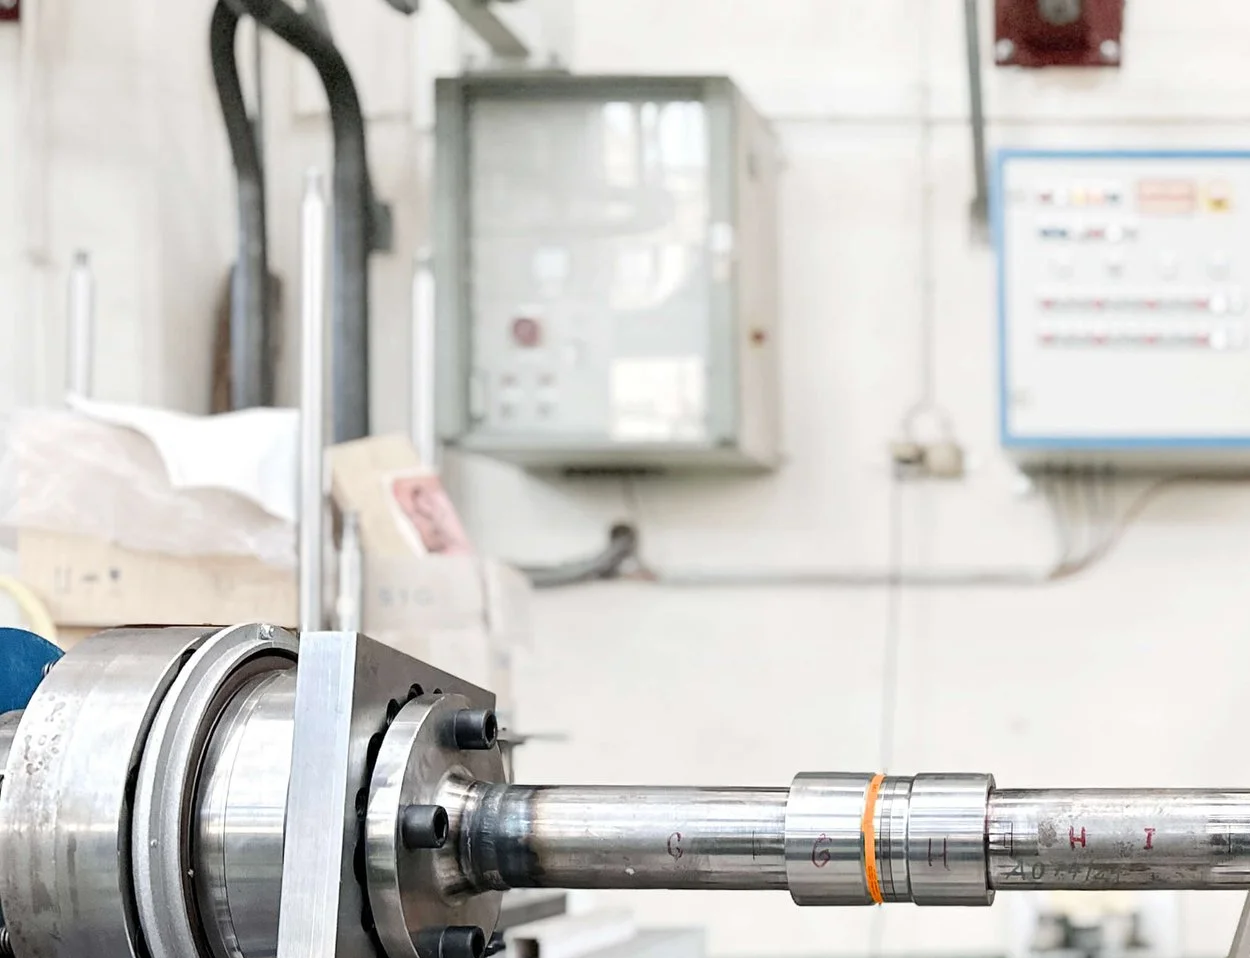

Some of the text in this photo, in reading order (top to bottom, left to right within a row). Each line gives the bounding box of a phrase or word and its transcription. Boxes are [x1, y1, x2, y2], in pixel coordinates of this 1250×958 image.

[811, 833, 832, 868] G
[1069, 826, 1086, 849] H
[1144, 828, 1156, 850] I
[928, 838, 950, 871] H
